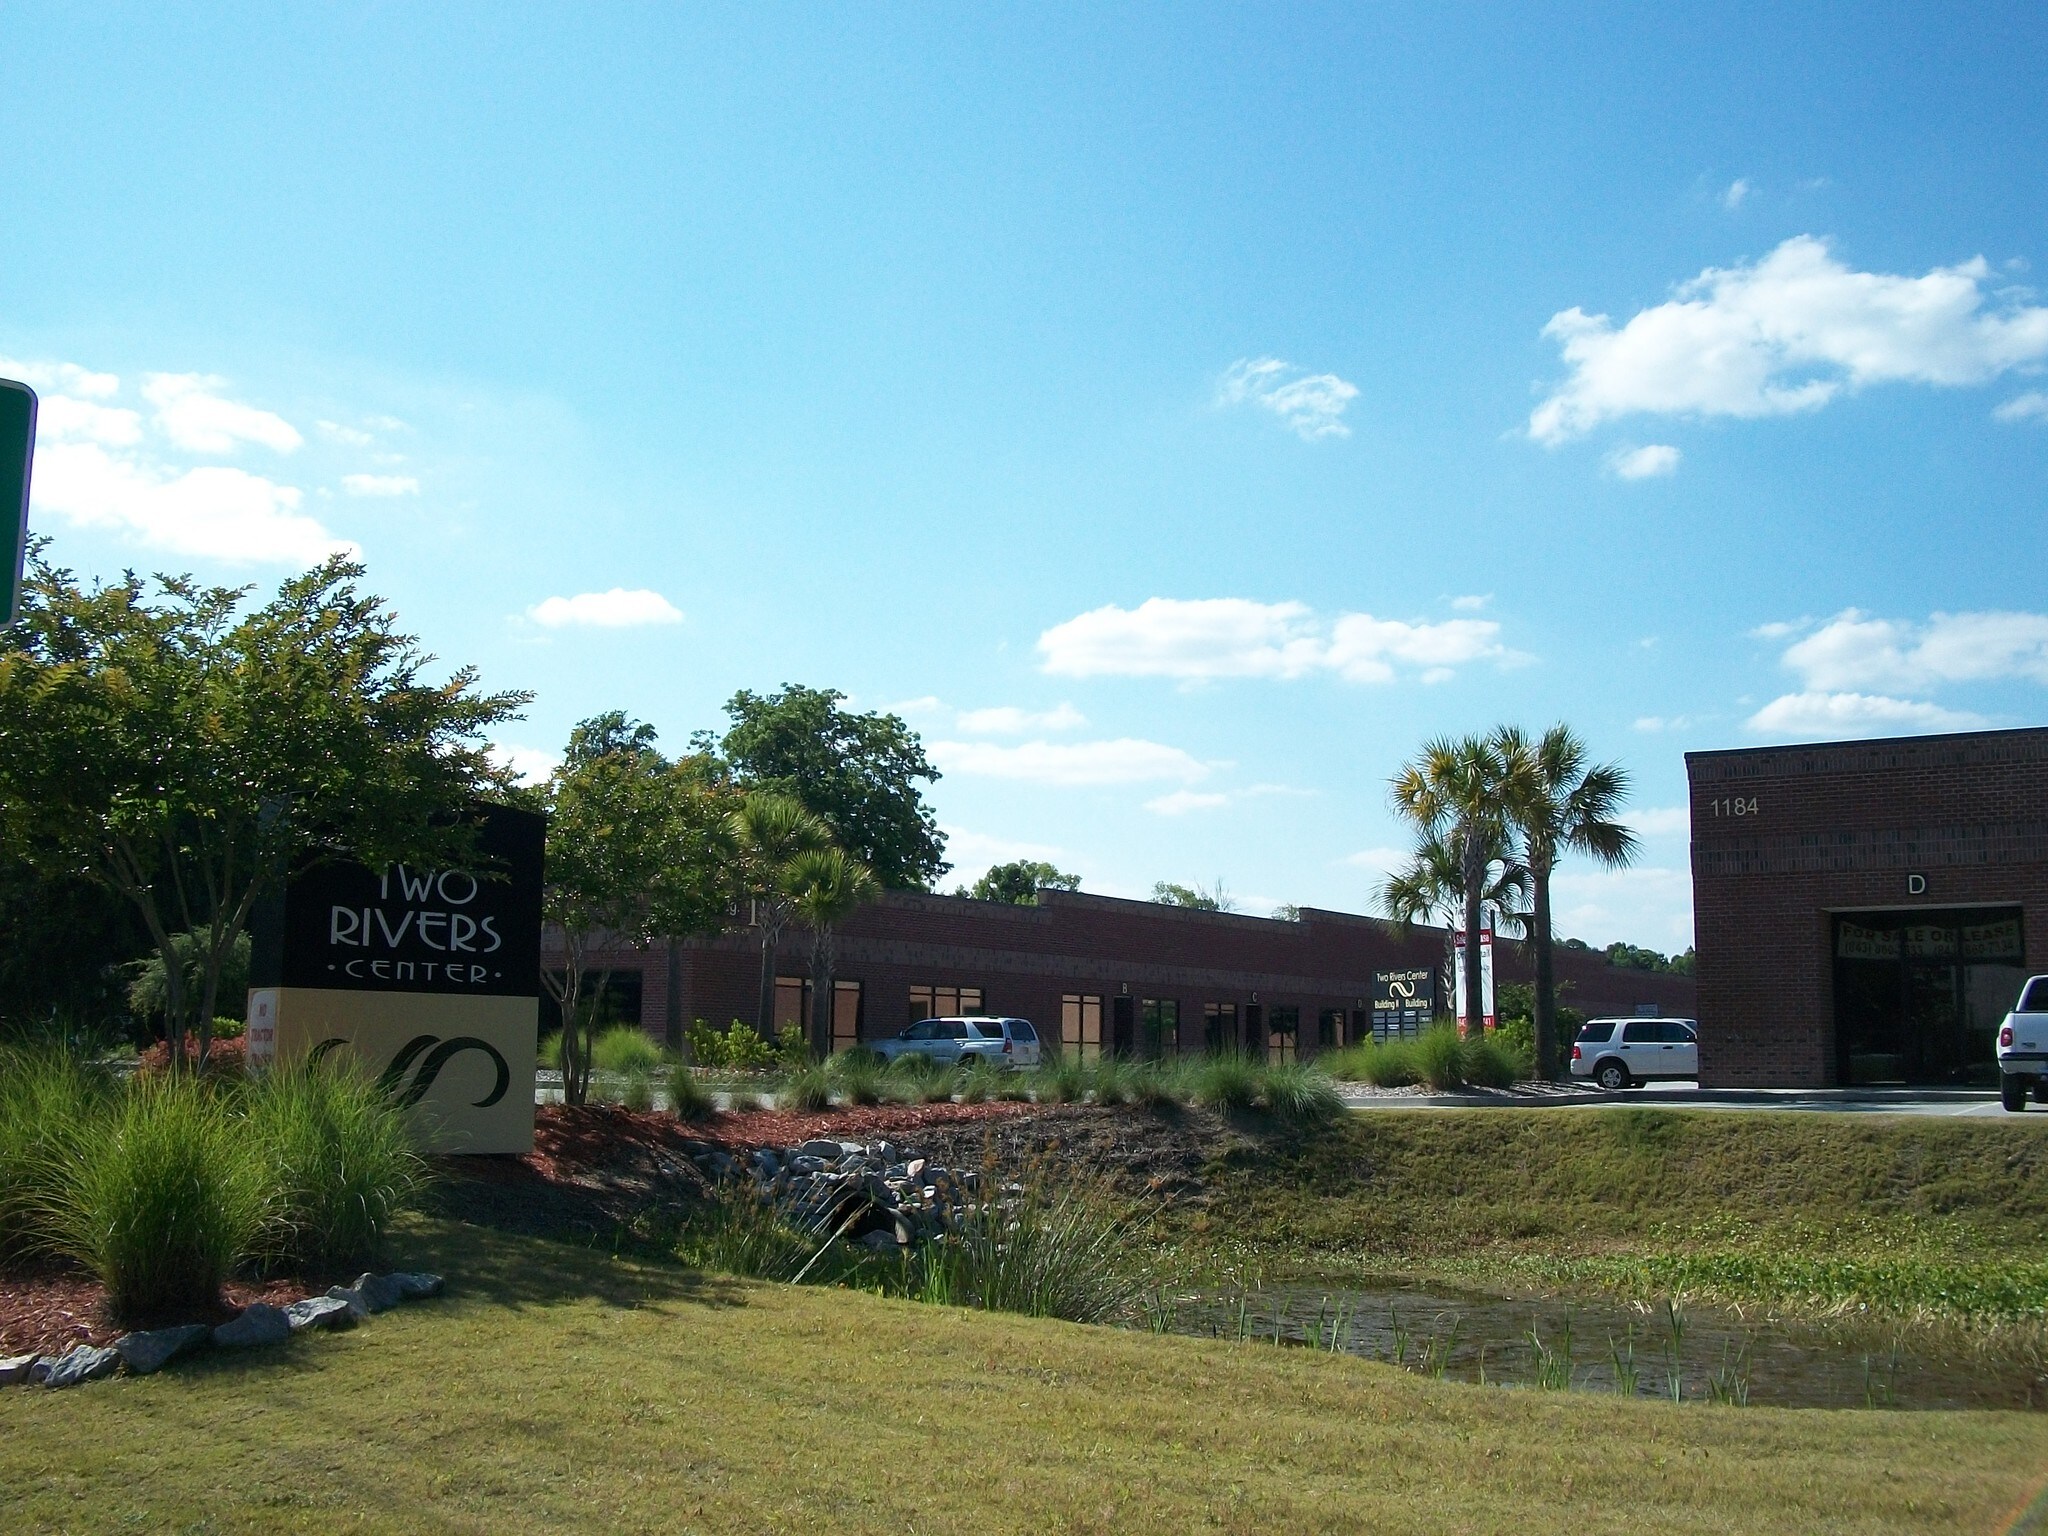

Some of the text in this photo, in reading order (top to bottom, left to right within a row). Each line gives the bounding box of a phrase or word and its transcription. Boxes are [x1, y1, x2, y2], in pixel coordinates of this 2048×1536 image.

[1710, 797, 1760, 817] 1184
[380, 862, 478, 905] TWO
[1908, 874, 1926, 894] D
[330, 905, 502, 952] RIVERS
[1842, 924, 1875, 940] FOR
[1931, 930, 1954, 943] OR
[345, 959, 487, 983] CENTER
[1377, 970, 1428, 982] Two Rivers Center
[1122, 983, 1128, 994] B
[1252, 992, 1258, 1002] C
[1374, 1000, 1395, 1010] Building
[1405, 998, 1428, 1009] Building
